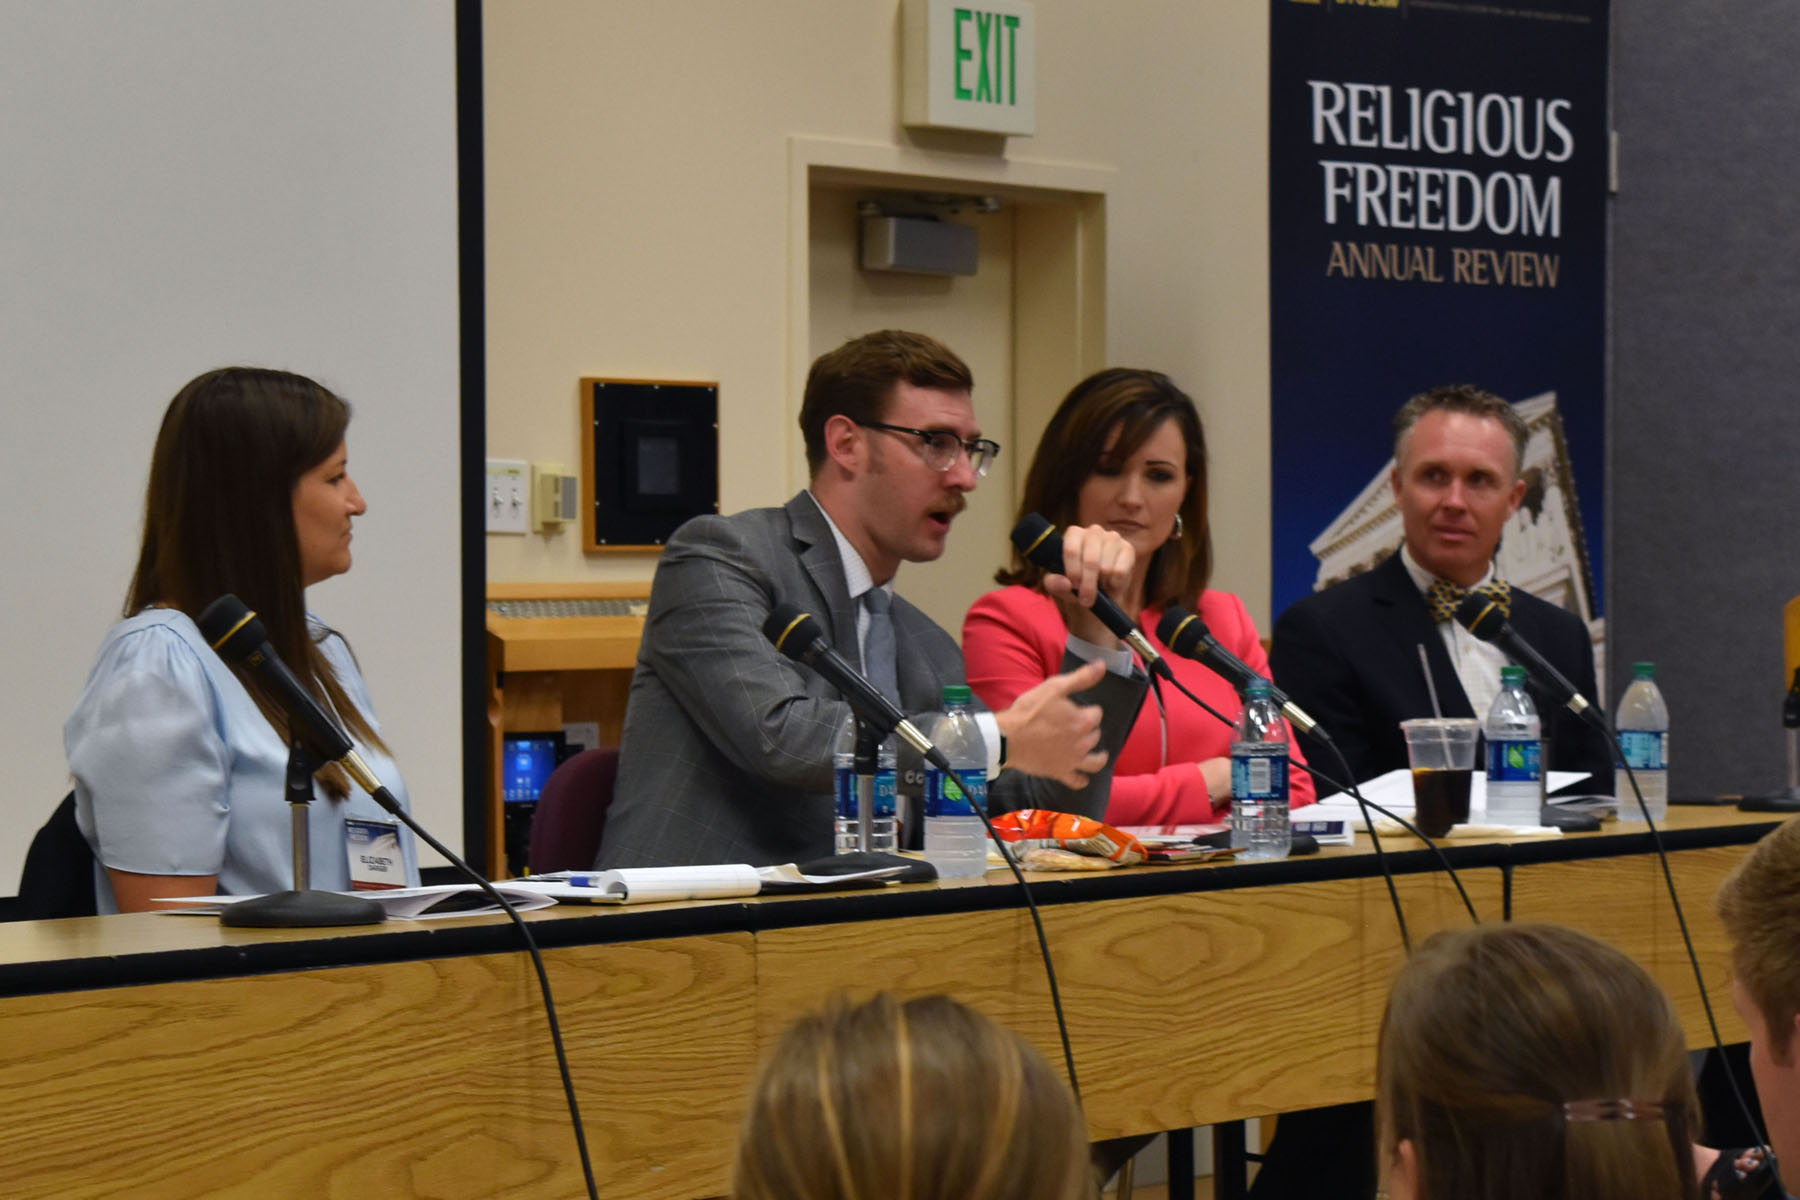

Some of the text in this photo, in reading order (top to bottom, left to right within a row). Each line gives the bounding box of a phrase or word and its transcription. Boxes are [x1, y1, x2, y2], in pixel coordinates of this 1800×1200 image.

[954, 8, 1020, 105] EXIT
[1307, 80, 1574, 162] RELIGIOUS
[1318, 160, 1561, 238] FREEDOM
[1326, 242, 1560, 288] ANNUAL REVIEW
